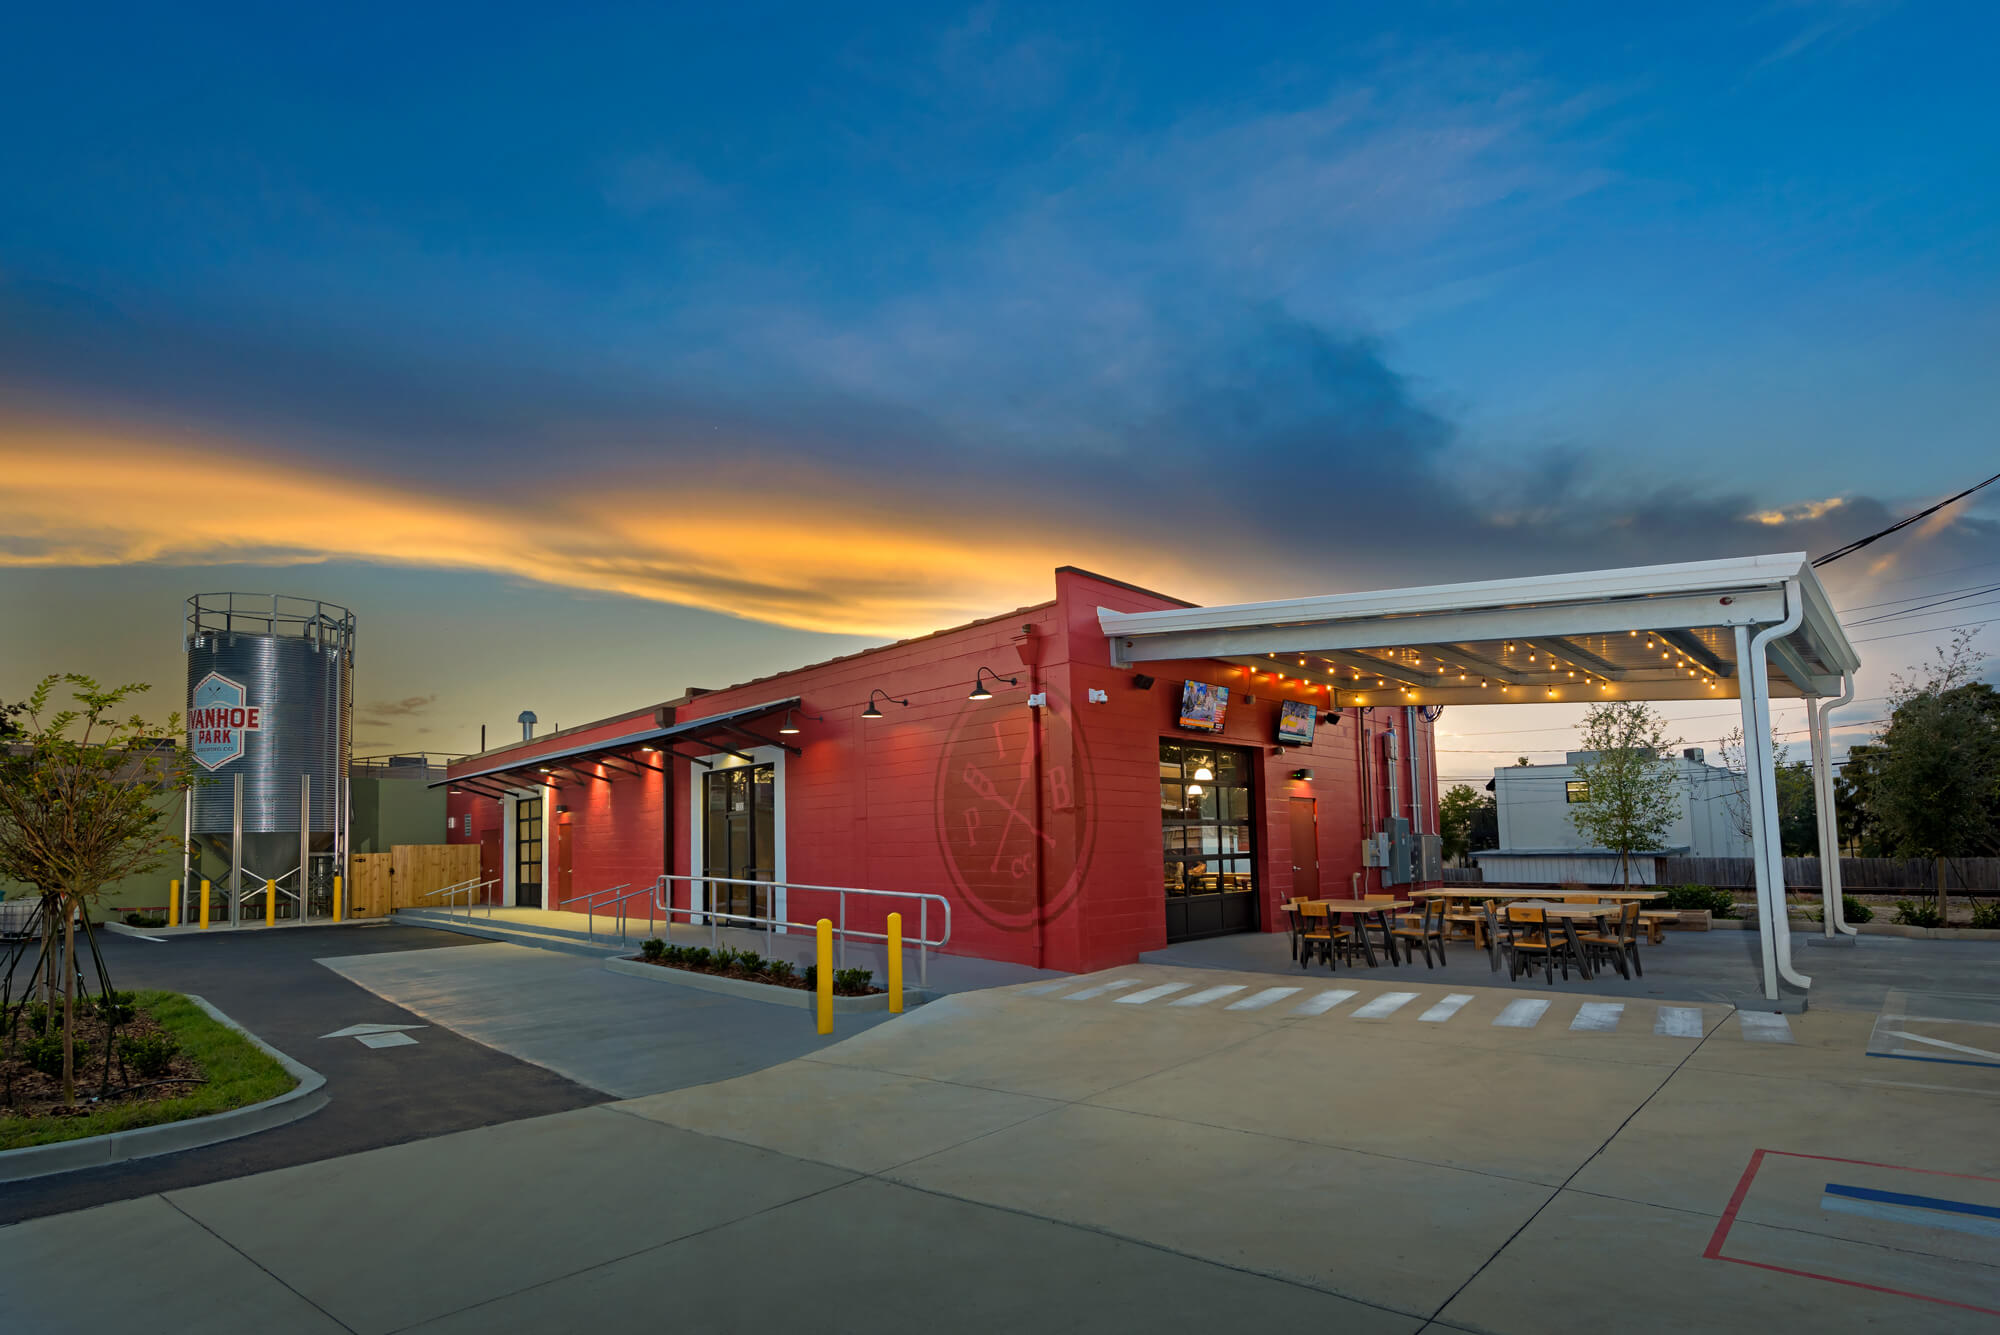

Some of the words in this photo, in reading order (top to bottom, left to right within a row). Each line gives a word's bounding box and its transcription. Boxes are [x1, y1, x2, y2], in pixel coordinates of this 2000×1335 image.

[198, 730, 231, 744] PARK
[1049, 766, 1074, 811] B
[964, 807, 980, 847] P
